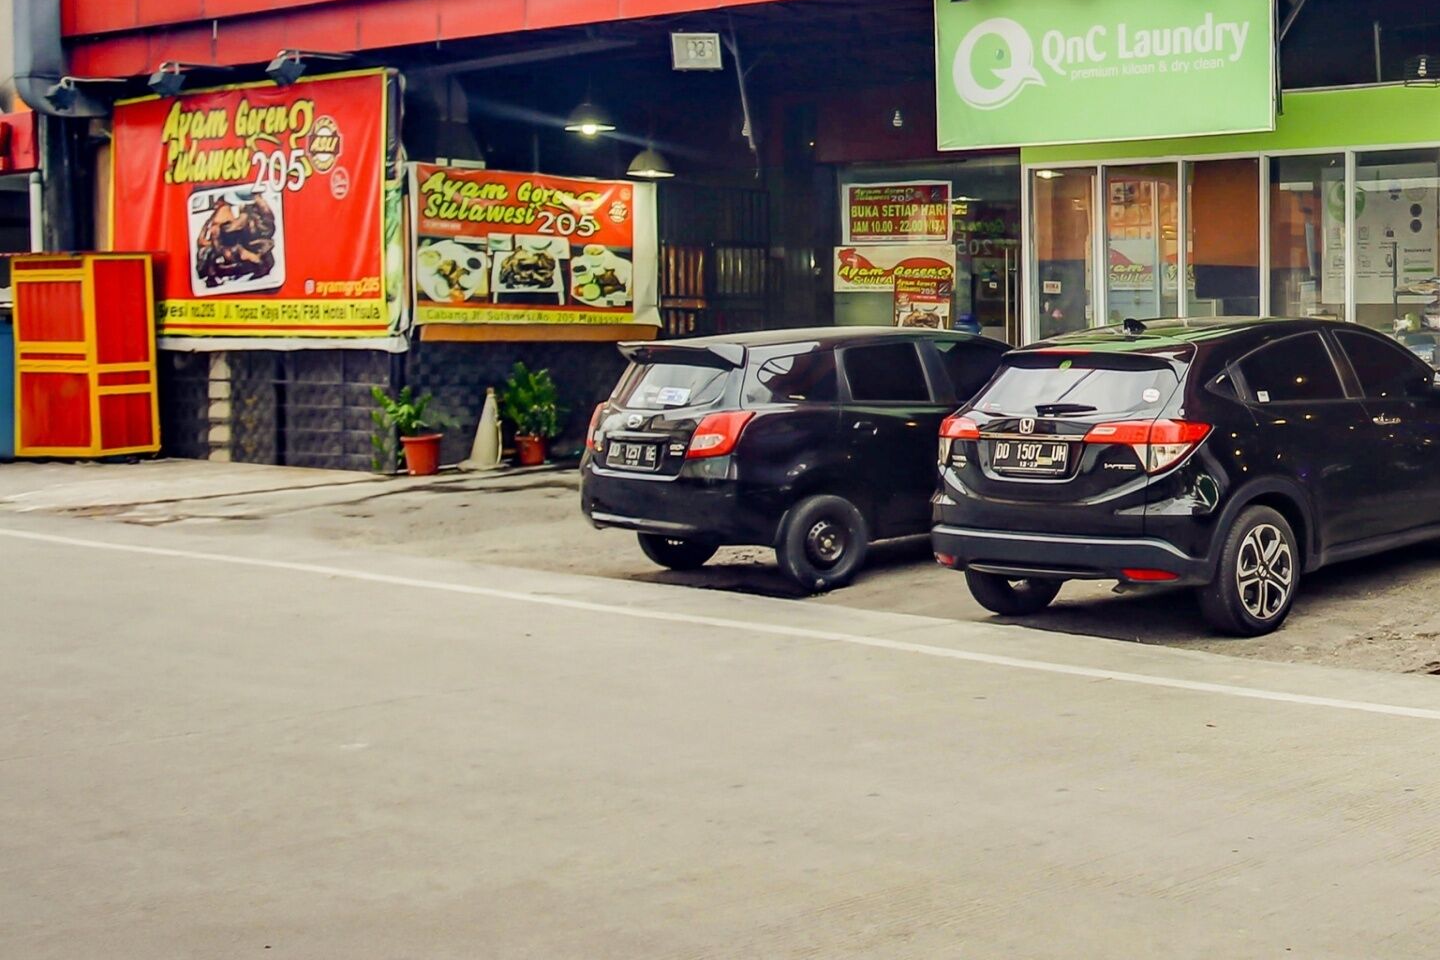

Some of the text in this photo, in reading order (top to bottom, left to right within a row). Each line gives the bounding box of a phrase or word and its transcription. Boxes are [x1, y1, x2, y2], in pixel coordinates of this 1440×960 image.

[1041, 25, 1106, 76] QnC
[1117, 12, 1249, 62] Laundry
[1071, 57, 1224, 81] premium kiloan & dry clean
[163, 101, 228, 150] Ayam
[165, 139, 251, 184] Sulawesi
[252, 149, 306, 192] 205
[421, 172, 509, 200] Ayam
[424, 193, 596, 236] Sulawesi 205
[851, 205, 879, 218] BUKA
[882, 203, 918, 217] SETIAP
[921, 203, 947, 216] HARI
[851, 221, 869, 233] JAM
[871, 220, 893, 233] 10.00
[838, 265, 885, 279] Ayam
[235, 304, 259, 320] Topaz
[323, 305, 347, 320] Hotel
[349, 304, 381, 320] Trisula
[996, 443, 1066, 462] DD 1507 UH
